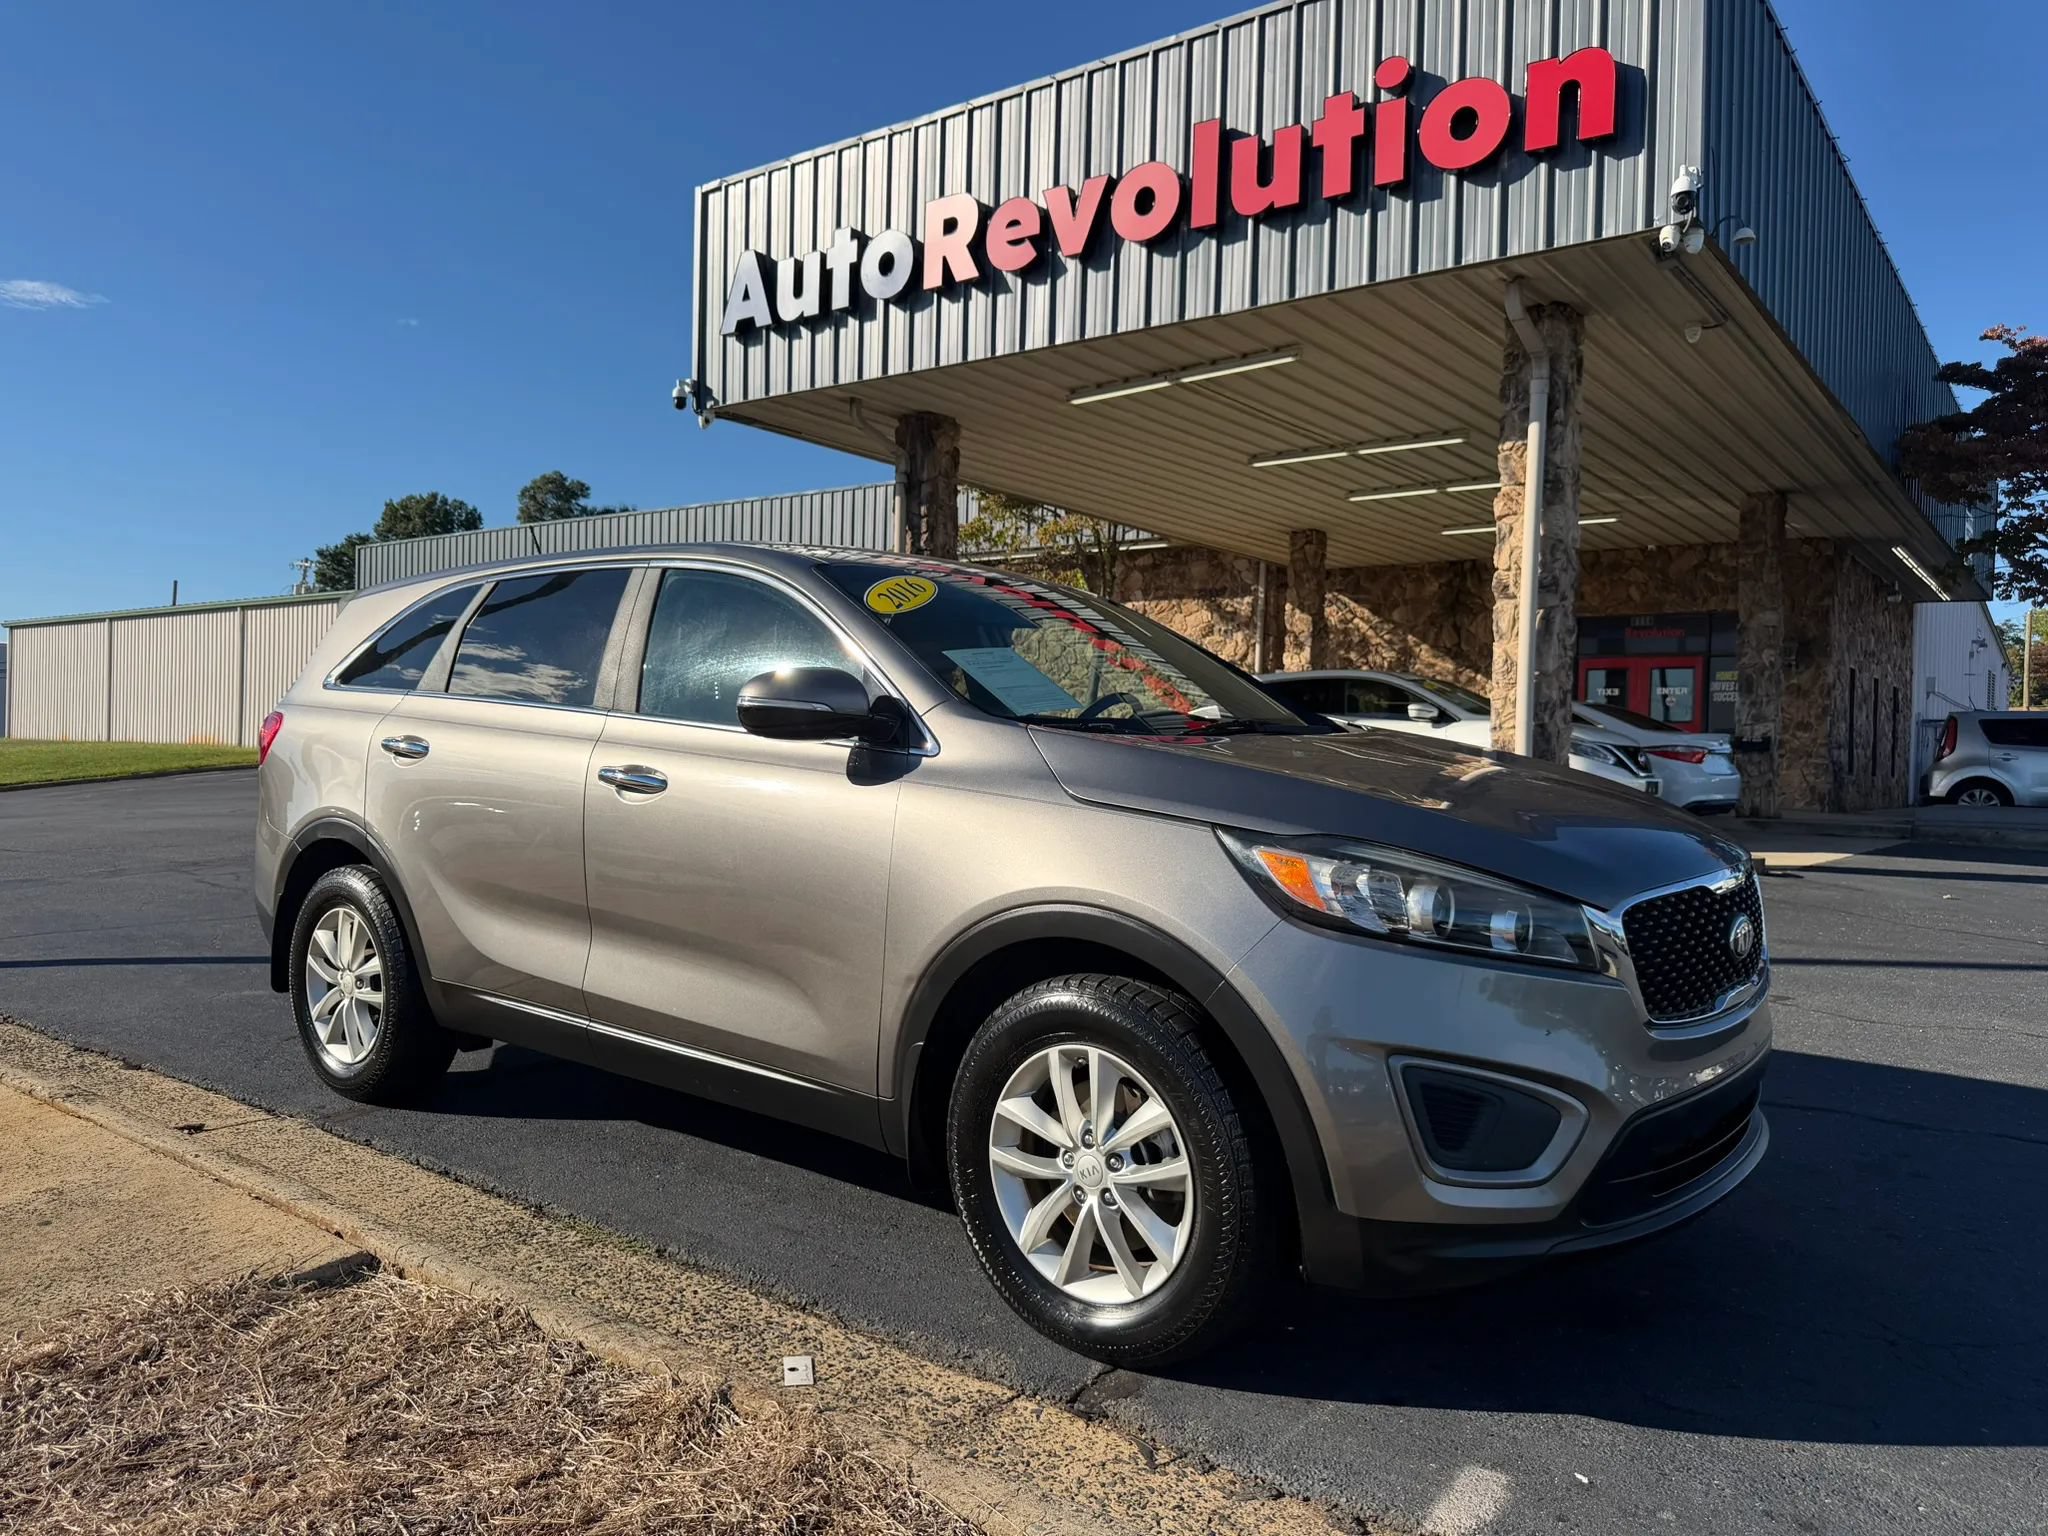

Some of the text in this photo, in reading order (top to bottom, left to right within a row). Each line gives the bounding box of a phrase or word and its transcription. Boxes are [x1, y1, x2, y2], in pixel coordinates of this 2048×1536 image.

[878, 578, 926, 608] 2016
[1656, 687, 1688, 695] ENTER
[1079, 1165, 1100, 1180] KIA
